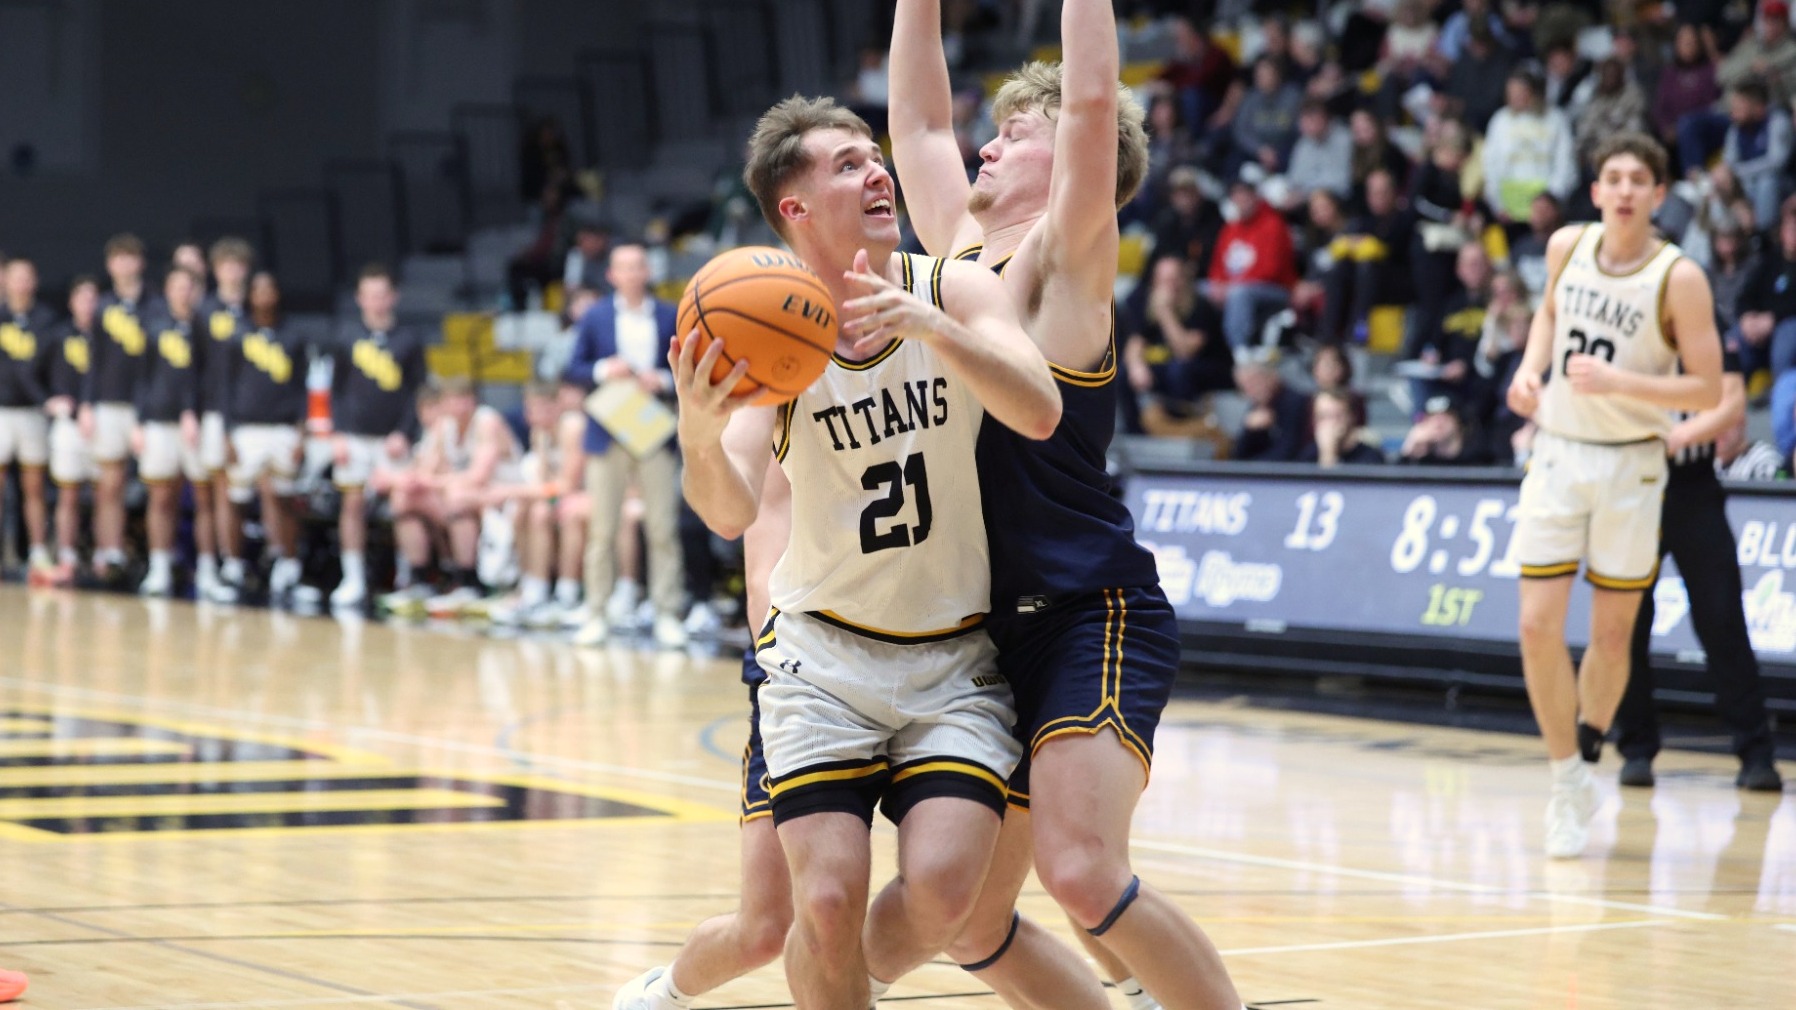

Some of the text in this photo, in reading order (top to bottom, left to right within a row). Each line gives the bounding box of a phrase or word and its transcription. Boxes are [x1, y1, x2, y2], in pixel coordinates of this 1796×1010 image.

[1564, 285, 1645, 338] TITANS
[813, 377, 948, 451] TITANS
[860, 452, 933, 554] 21
[1140, 489, 1345, 551] TITANS 13
[1390, 494, 1522, 579] 8:51
[1420, 582, 1485, 627] 1ST
